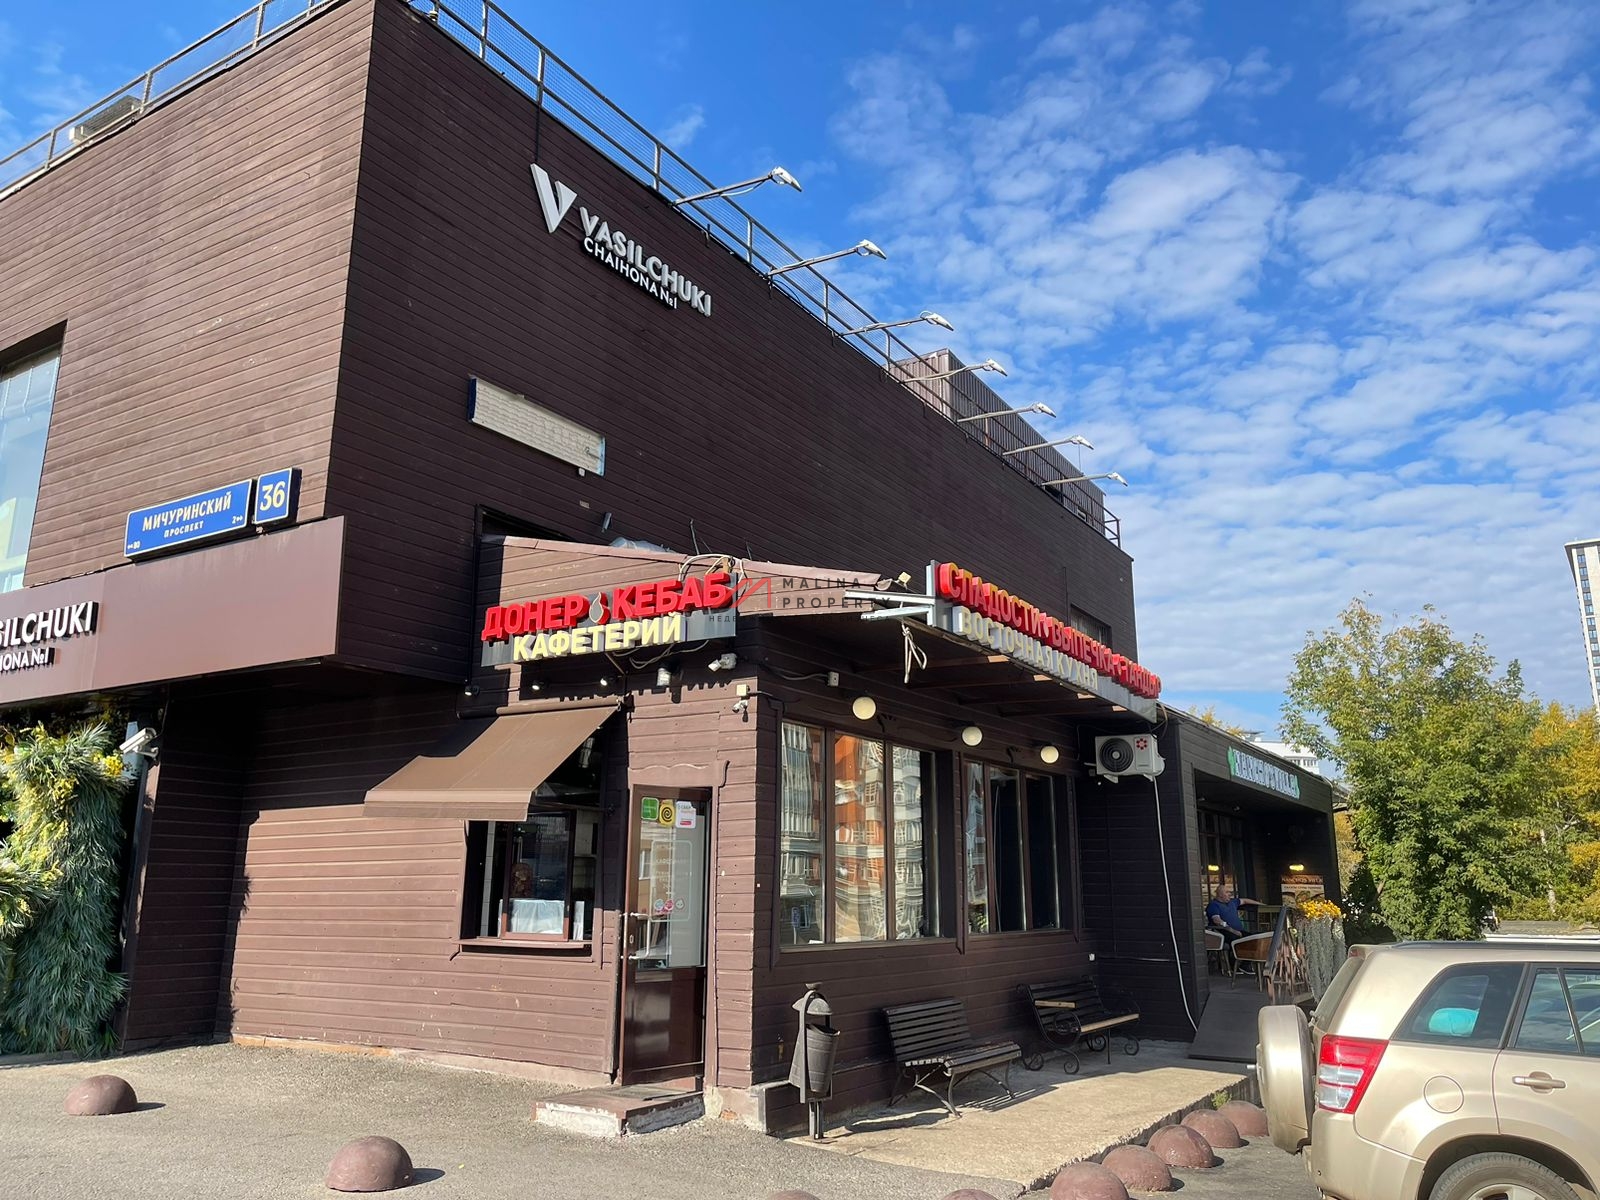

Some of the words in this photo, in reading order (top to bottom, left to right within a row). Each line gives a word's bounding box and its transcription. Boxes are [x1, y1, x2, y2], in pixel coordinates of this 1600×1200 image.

[579, 206, 712, 317] VASILCHUKI
[583, 236, 659, 300] CHAIHONA
[142, 491, 232, 532] МИЧУРИНСКИЙ
[259, 480, 286, 512] 36
[163, 520, 204, 539] ПРОСПЕКТ
[481, 594, 590, 641] ДОНЕР
[612, 572, 732, 621] КЕБАБ
[513, 611, 687, 661] КАФЕТЕРИЙ
[939, 561, 1043, 638] СЛАДОСТИ
[1049, 617, 1116, 676] ВЫПЕЧКА
[952, 605, 1054, 671] ВОСТОЧНАЯ
[1054, 651, 1099, 691] КУХНЯ
